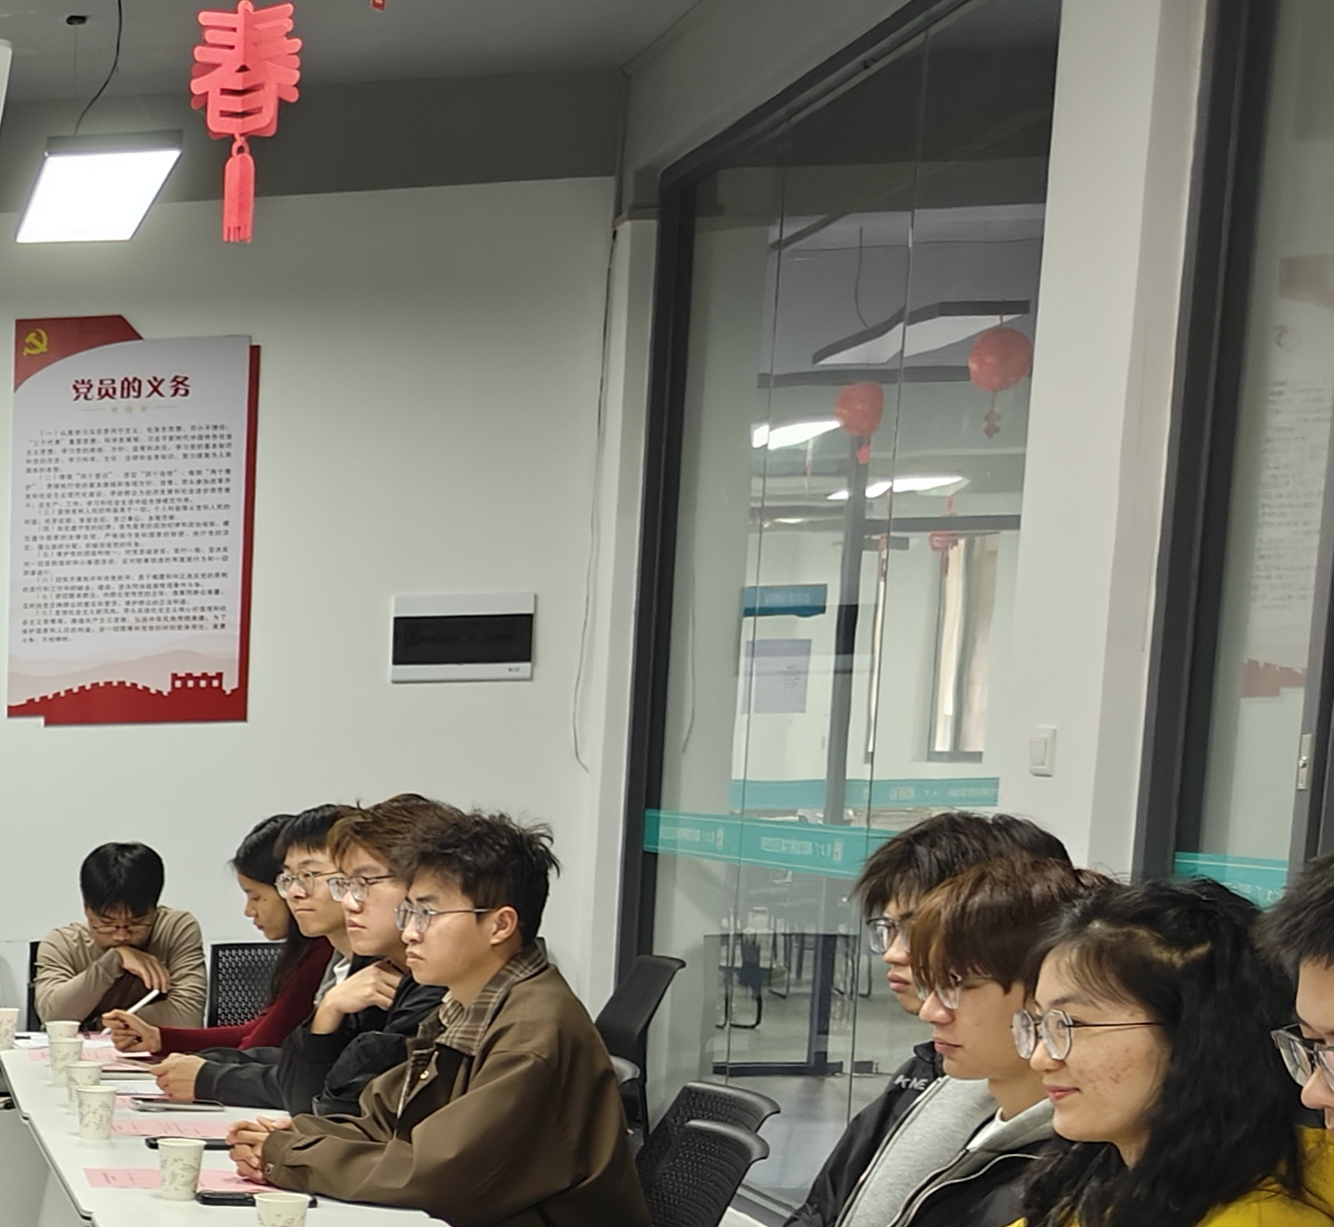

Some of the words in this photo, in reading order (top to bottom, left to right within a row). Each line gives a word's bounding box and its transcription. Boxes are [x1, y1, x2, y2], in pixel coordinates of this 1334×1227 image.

[71, 375, 192, 402] 党员的义务
